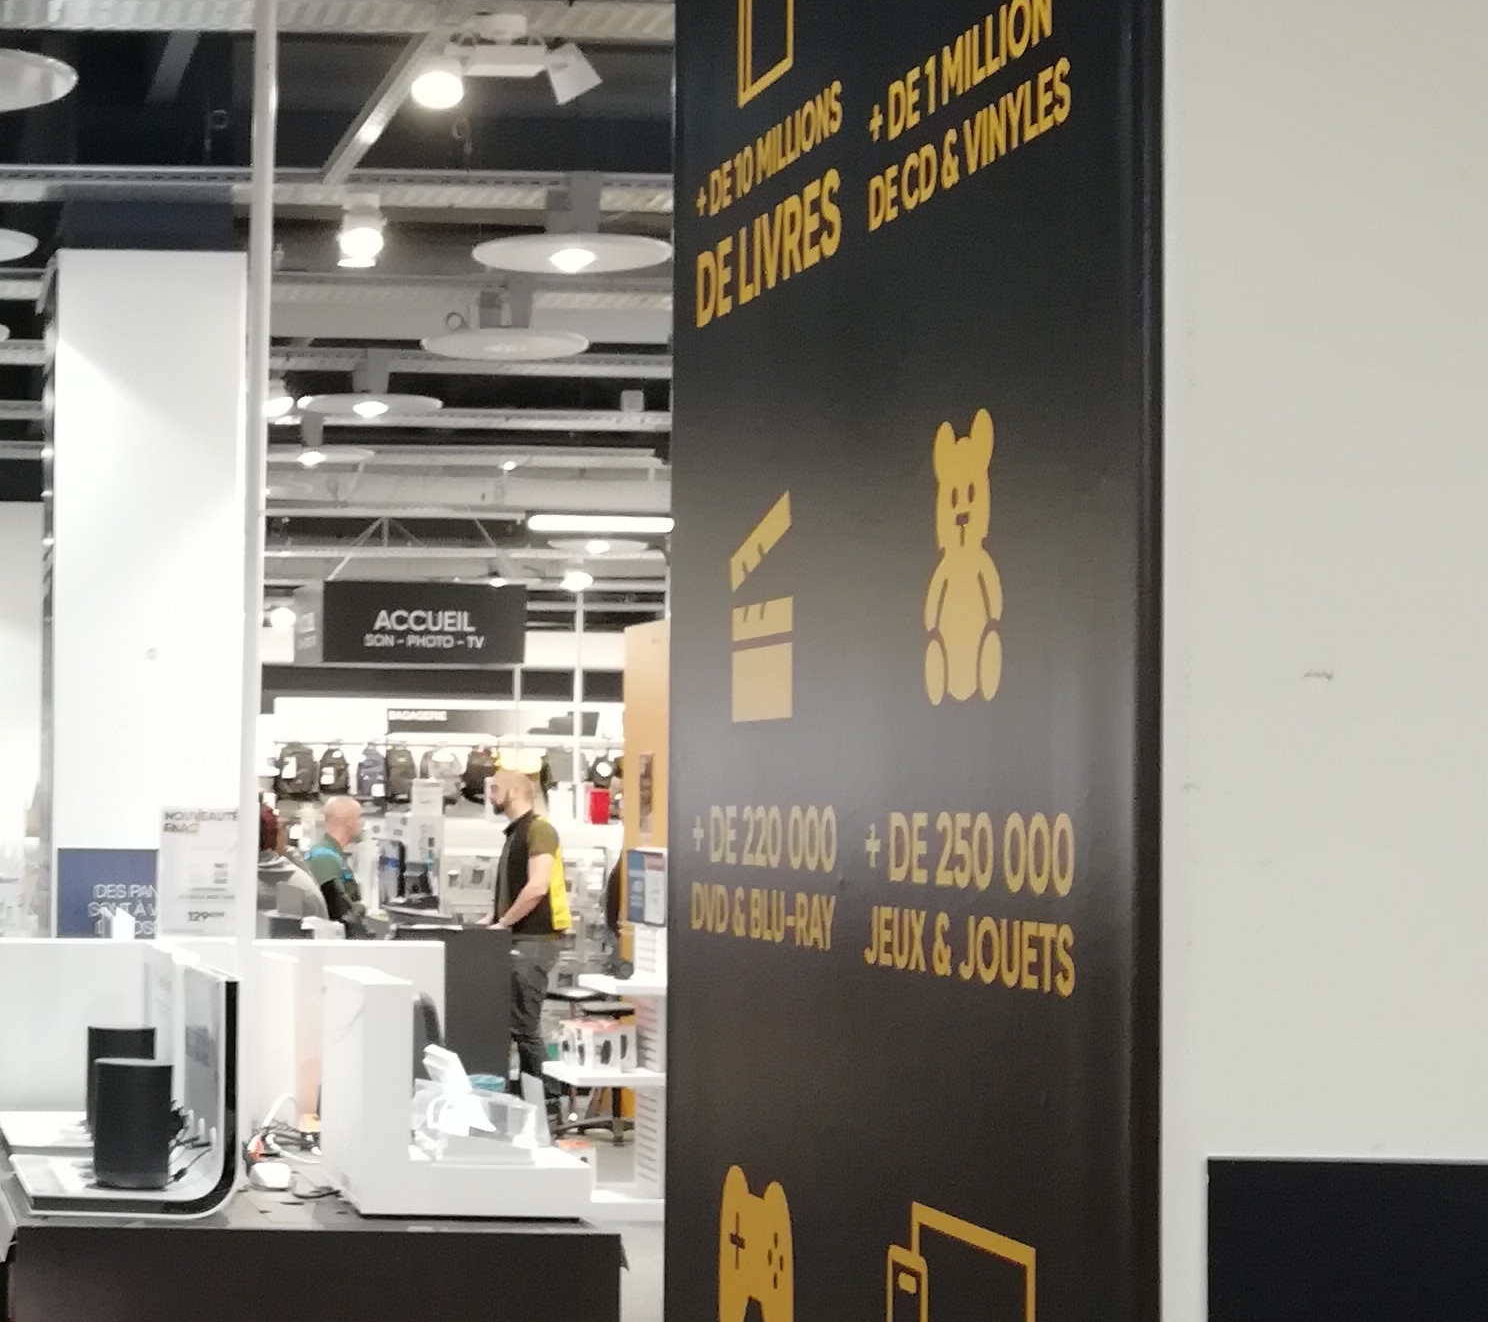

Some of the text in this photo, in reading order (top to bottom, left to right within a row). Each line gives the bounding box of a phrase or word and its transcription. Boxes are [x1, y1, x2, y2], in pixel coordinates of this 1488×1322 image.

[888, 67, 921, 142] DE
[925, 55, 937, 115] 1
[709, 156, 734, 215] DE
[733, 146, 753, 199] 10
[755, 80, 843, 182] MILLIONS
[869, 57, 1072, 232] DE CD & VINYLES
[696, 169, 842, 328] DE LIVRES
[364, 634, 395, 647] SON
[406, 635, 455, 649] PHOTO
[466, 635, 485, 649] TV
[373, 609, 477, 632] ACCUEIL
[710, 804, 738, 865] DE
[742, 804, 783, 869] 220
[788, 804, 838, 873] 000
[888, 812, 929, 885] DE
[935, 811, 994, 891] 250
[1003, 812, 1075, 898] 000
[93, 884, 128, 900] DES
[691, 882, 836, 951] DVD & BLU-RAY
[863, 906, 1076, 998] JEUX & JOUETS
